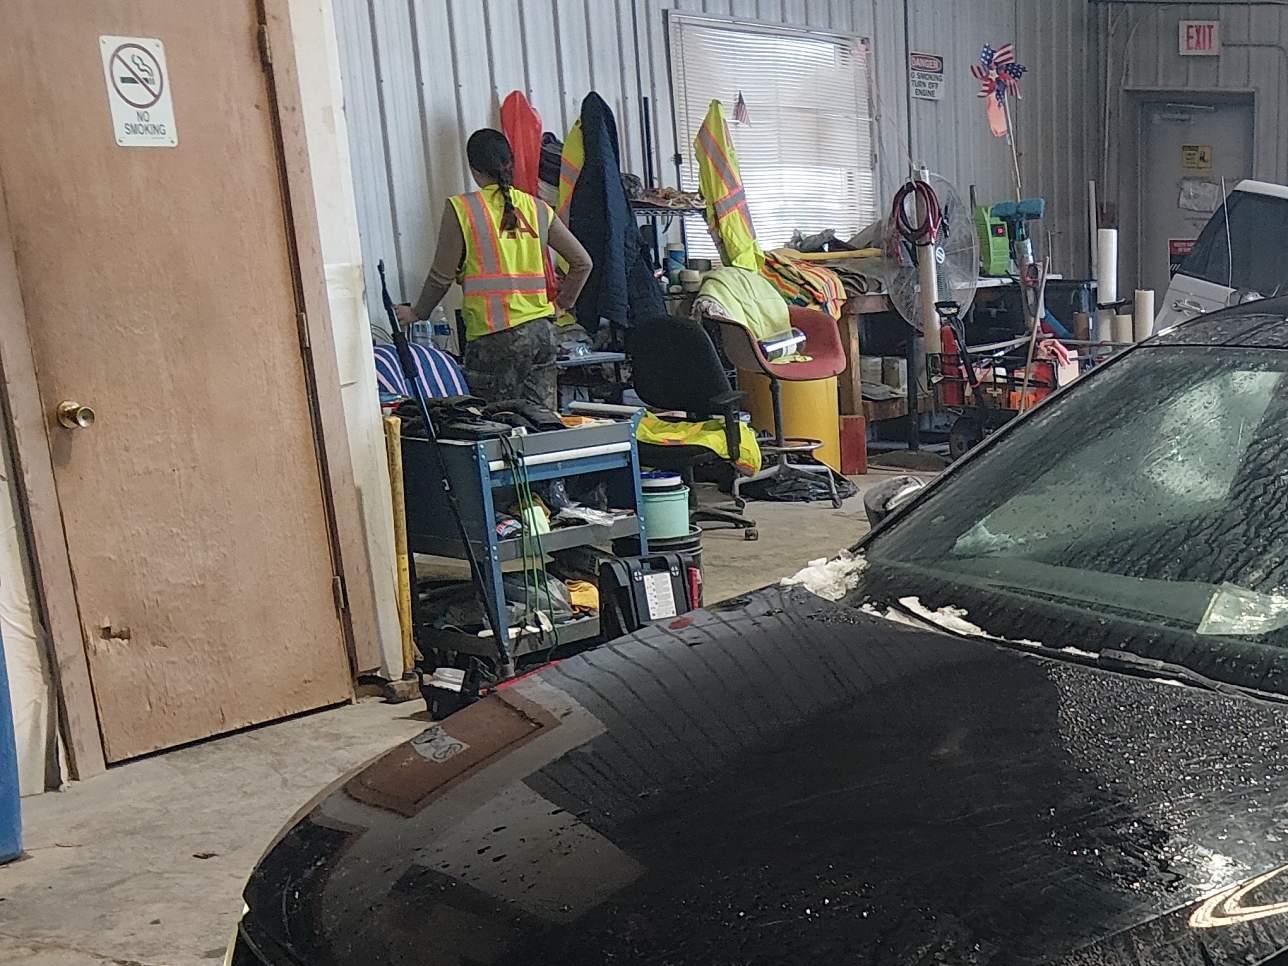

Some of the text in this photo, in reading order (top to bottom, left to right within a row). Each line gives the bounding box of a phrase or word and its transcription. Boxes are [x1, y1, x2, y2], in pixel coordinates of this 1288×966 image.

[1186, 24, 1214, 50] EXIT
[915, 88, 936, 97] ENGINE
[136, 110, 151, 123] NO
[124, 123, 167, 135] SMOKING
